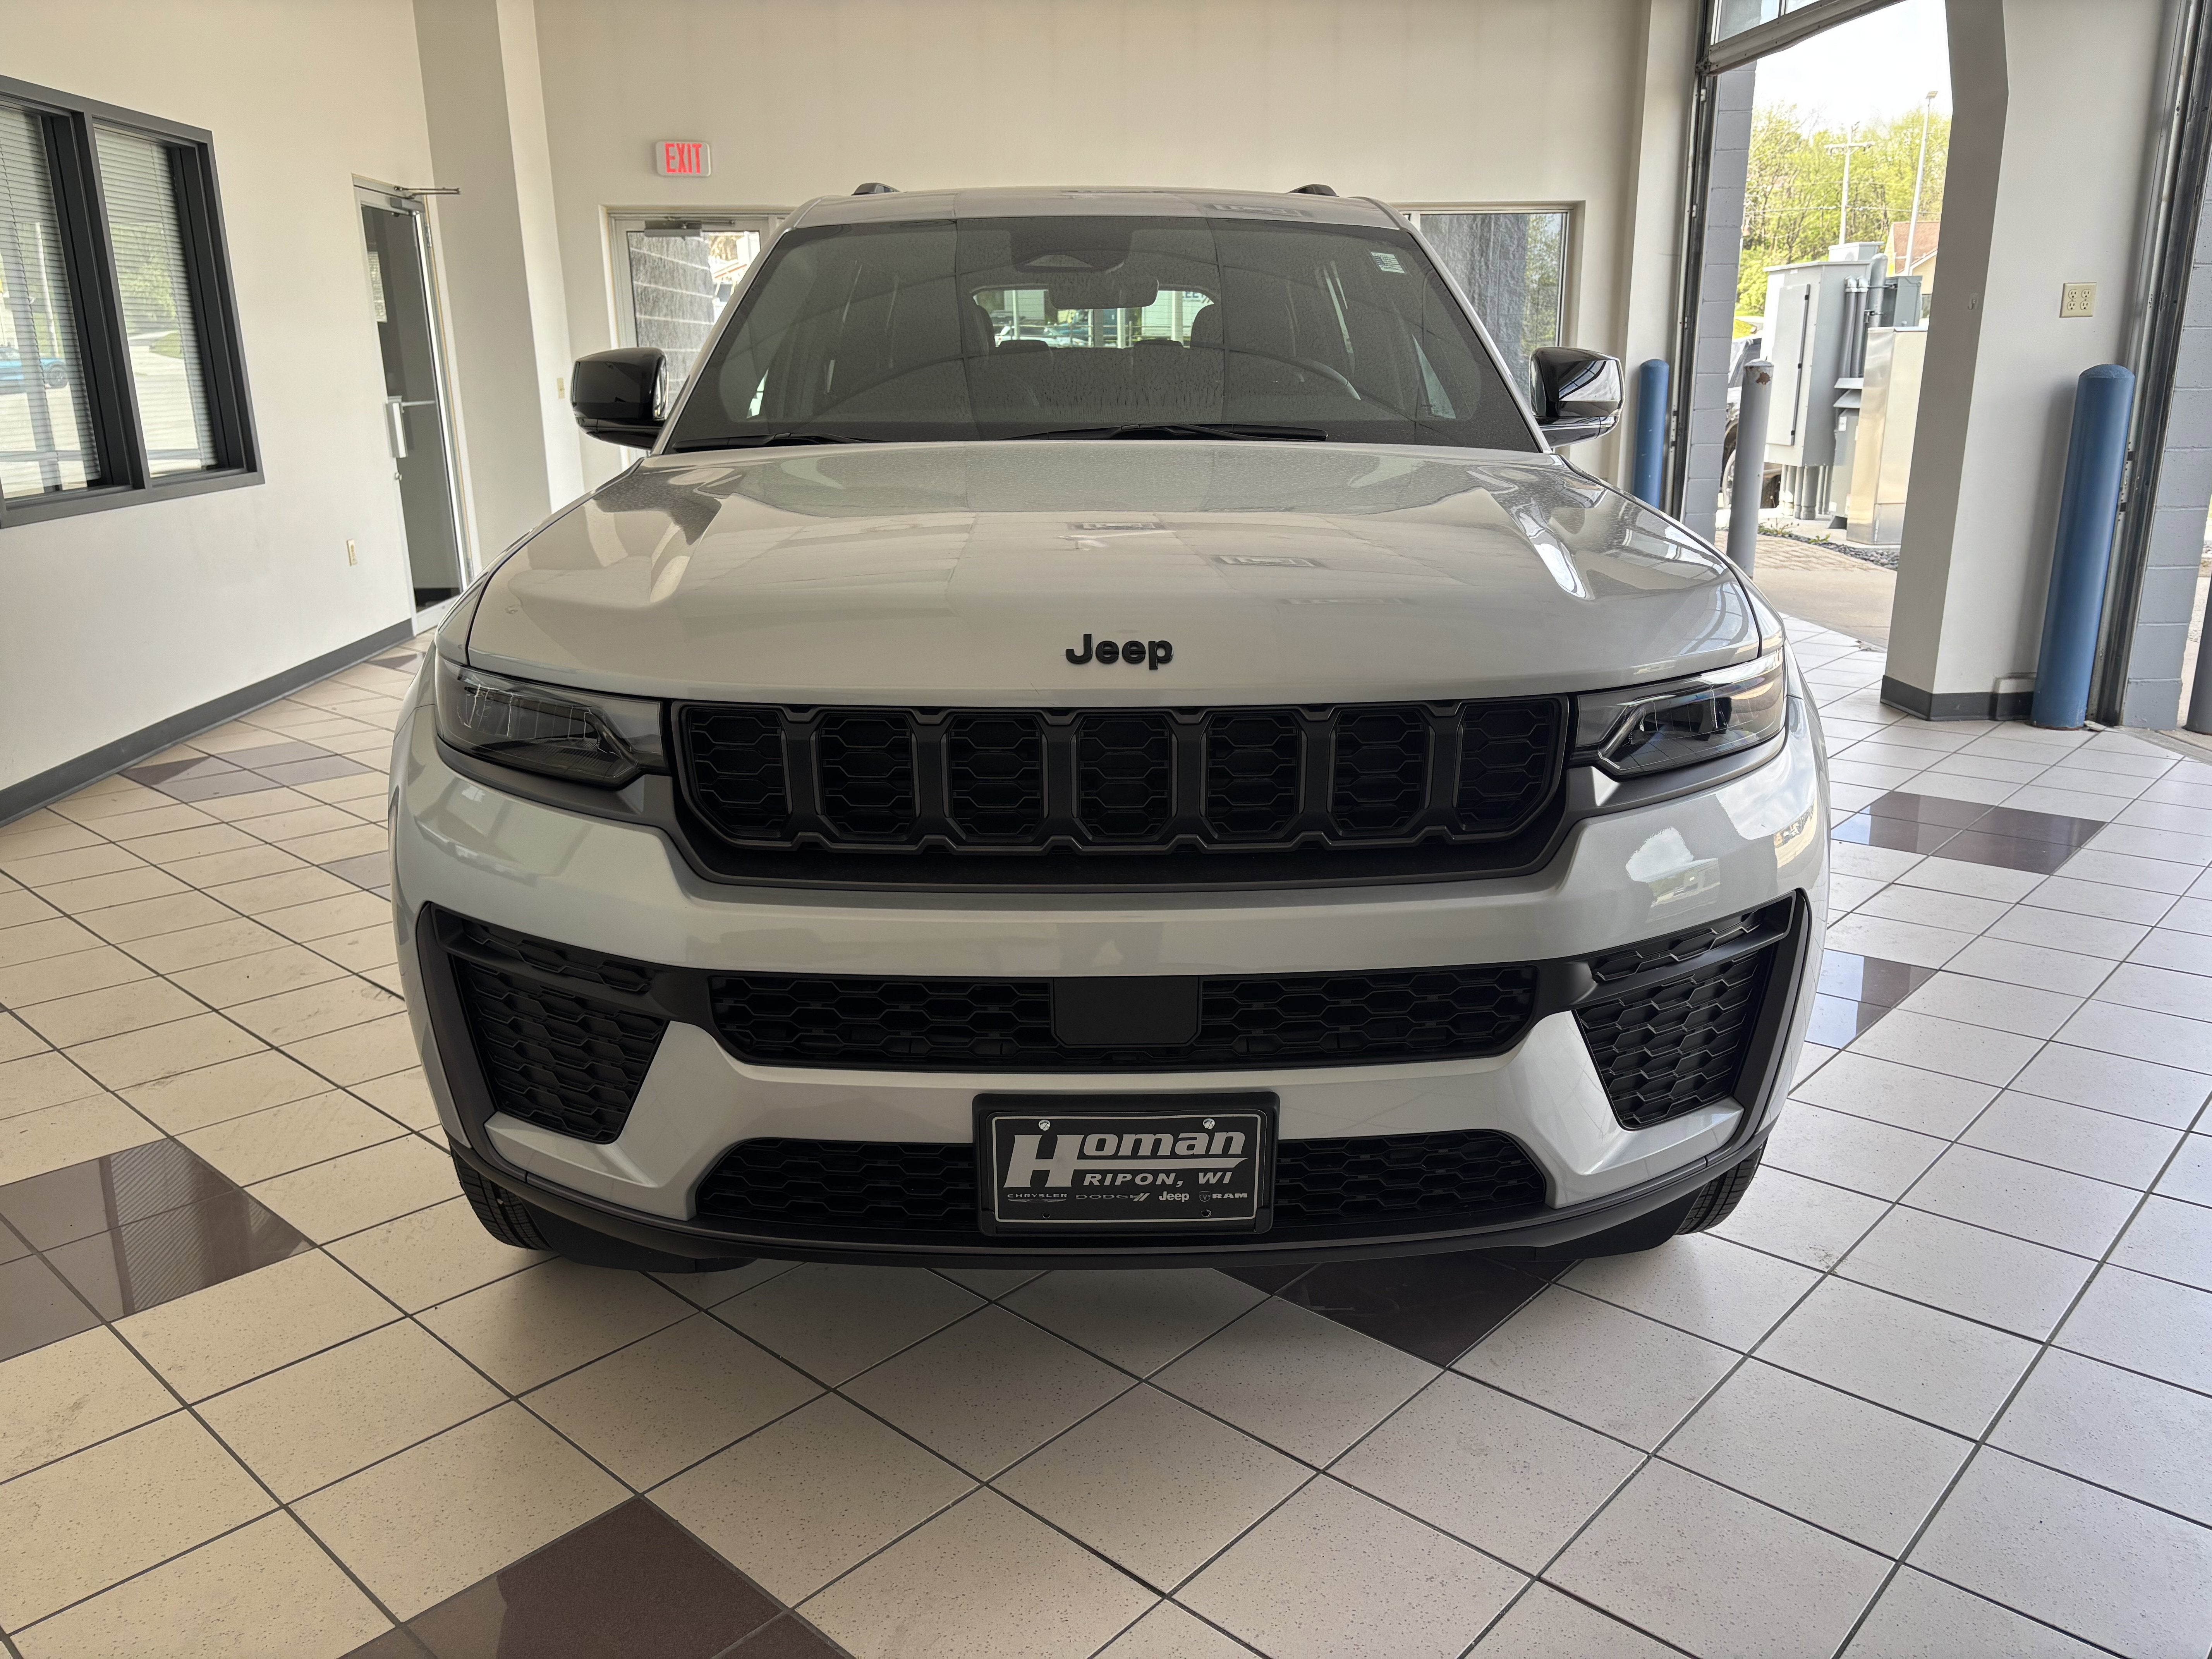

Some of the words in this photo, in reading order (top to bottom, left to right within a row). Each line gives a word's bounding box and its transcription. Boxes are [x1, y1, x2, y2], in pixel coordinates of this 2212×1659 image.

[665, 143, 702, 174] EXIT
[1066, 634, 1174, 670] Jeep
[1004, 1132, 1245, 1188] Homan
[1083, 1173, 1183, 1187] RIPON,
[1199, 1172, 1233, 1184] WI
[1159, 1191, 1190, 1202] Jeep
